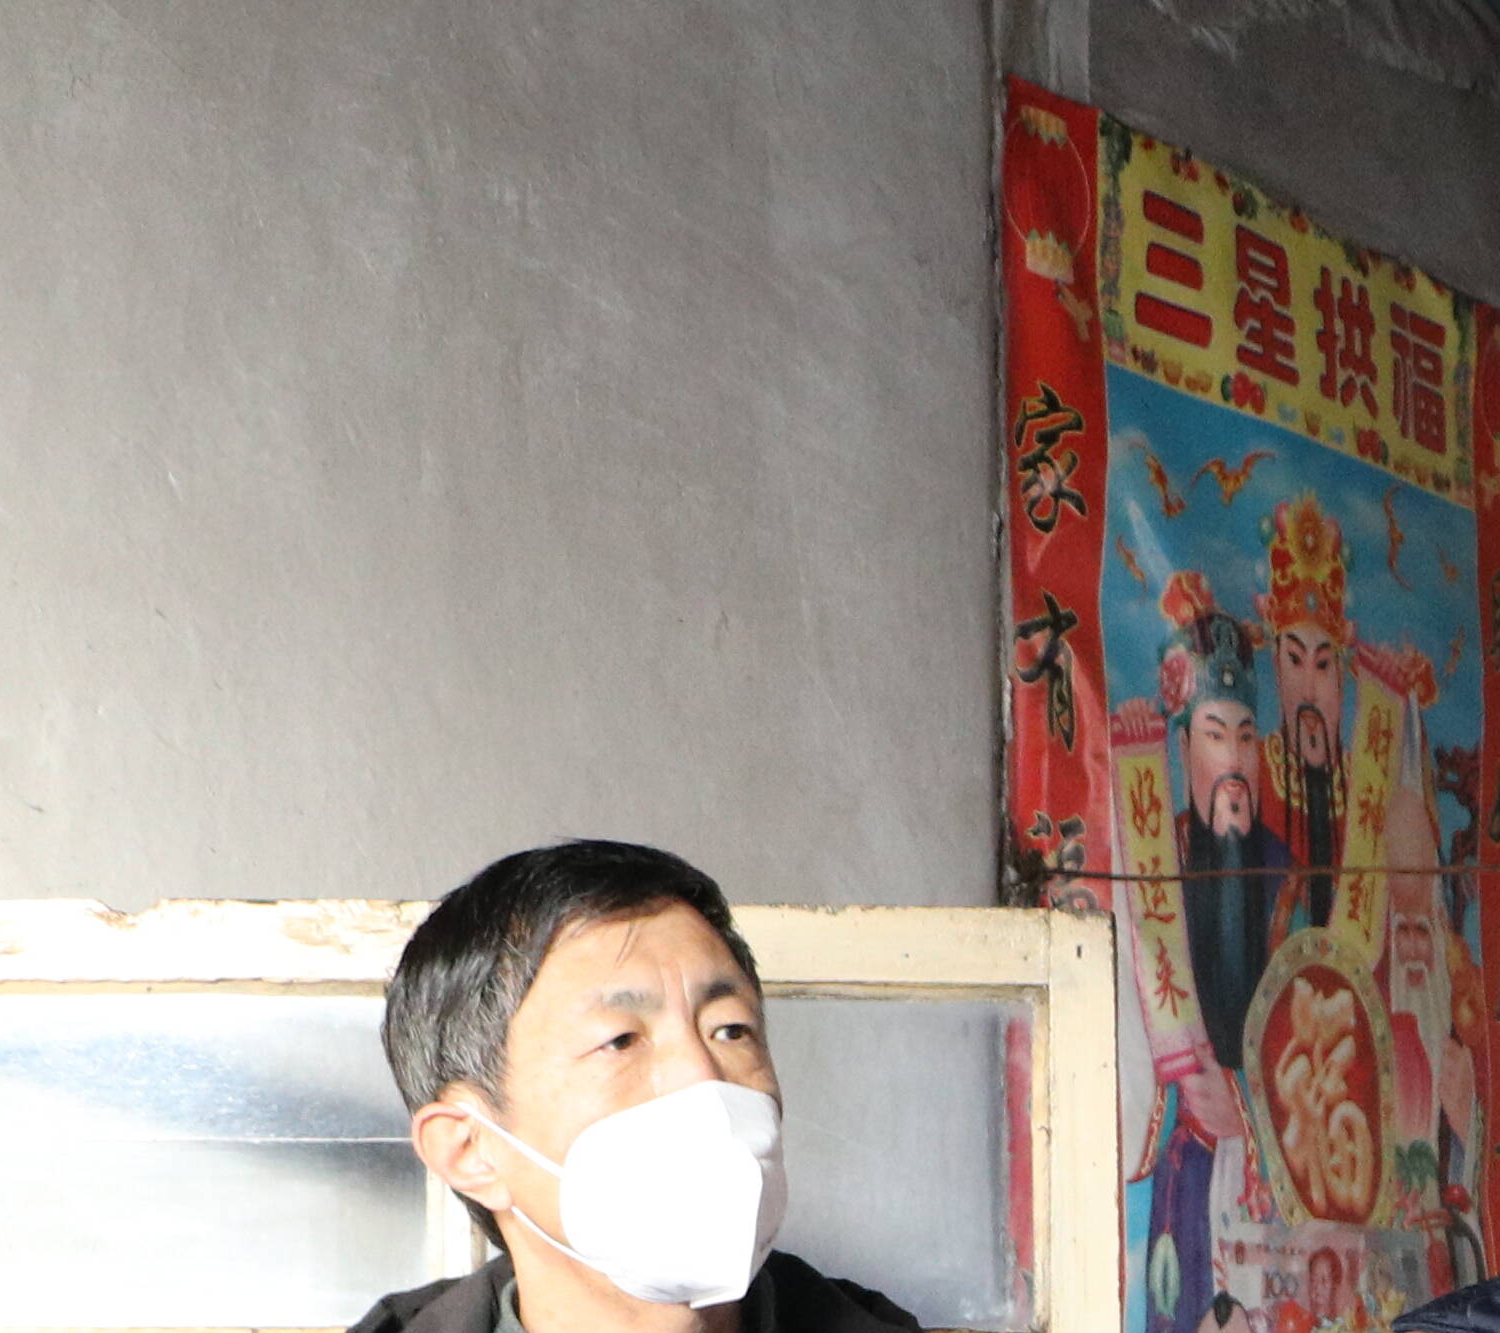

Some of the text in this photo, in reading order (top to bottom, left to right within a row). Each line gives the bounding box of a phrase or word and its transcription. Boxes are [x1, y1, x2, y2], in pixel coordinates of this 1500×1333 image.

[1133, 189, 1448, 455] 三星拱福
[1275, 976, 1376, 1214] 福
